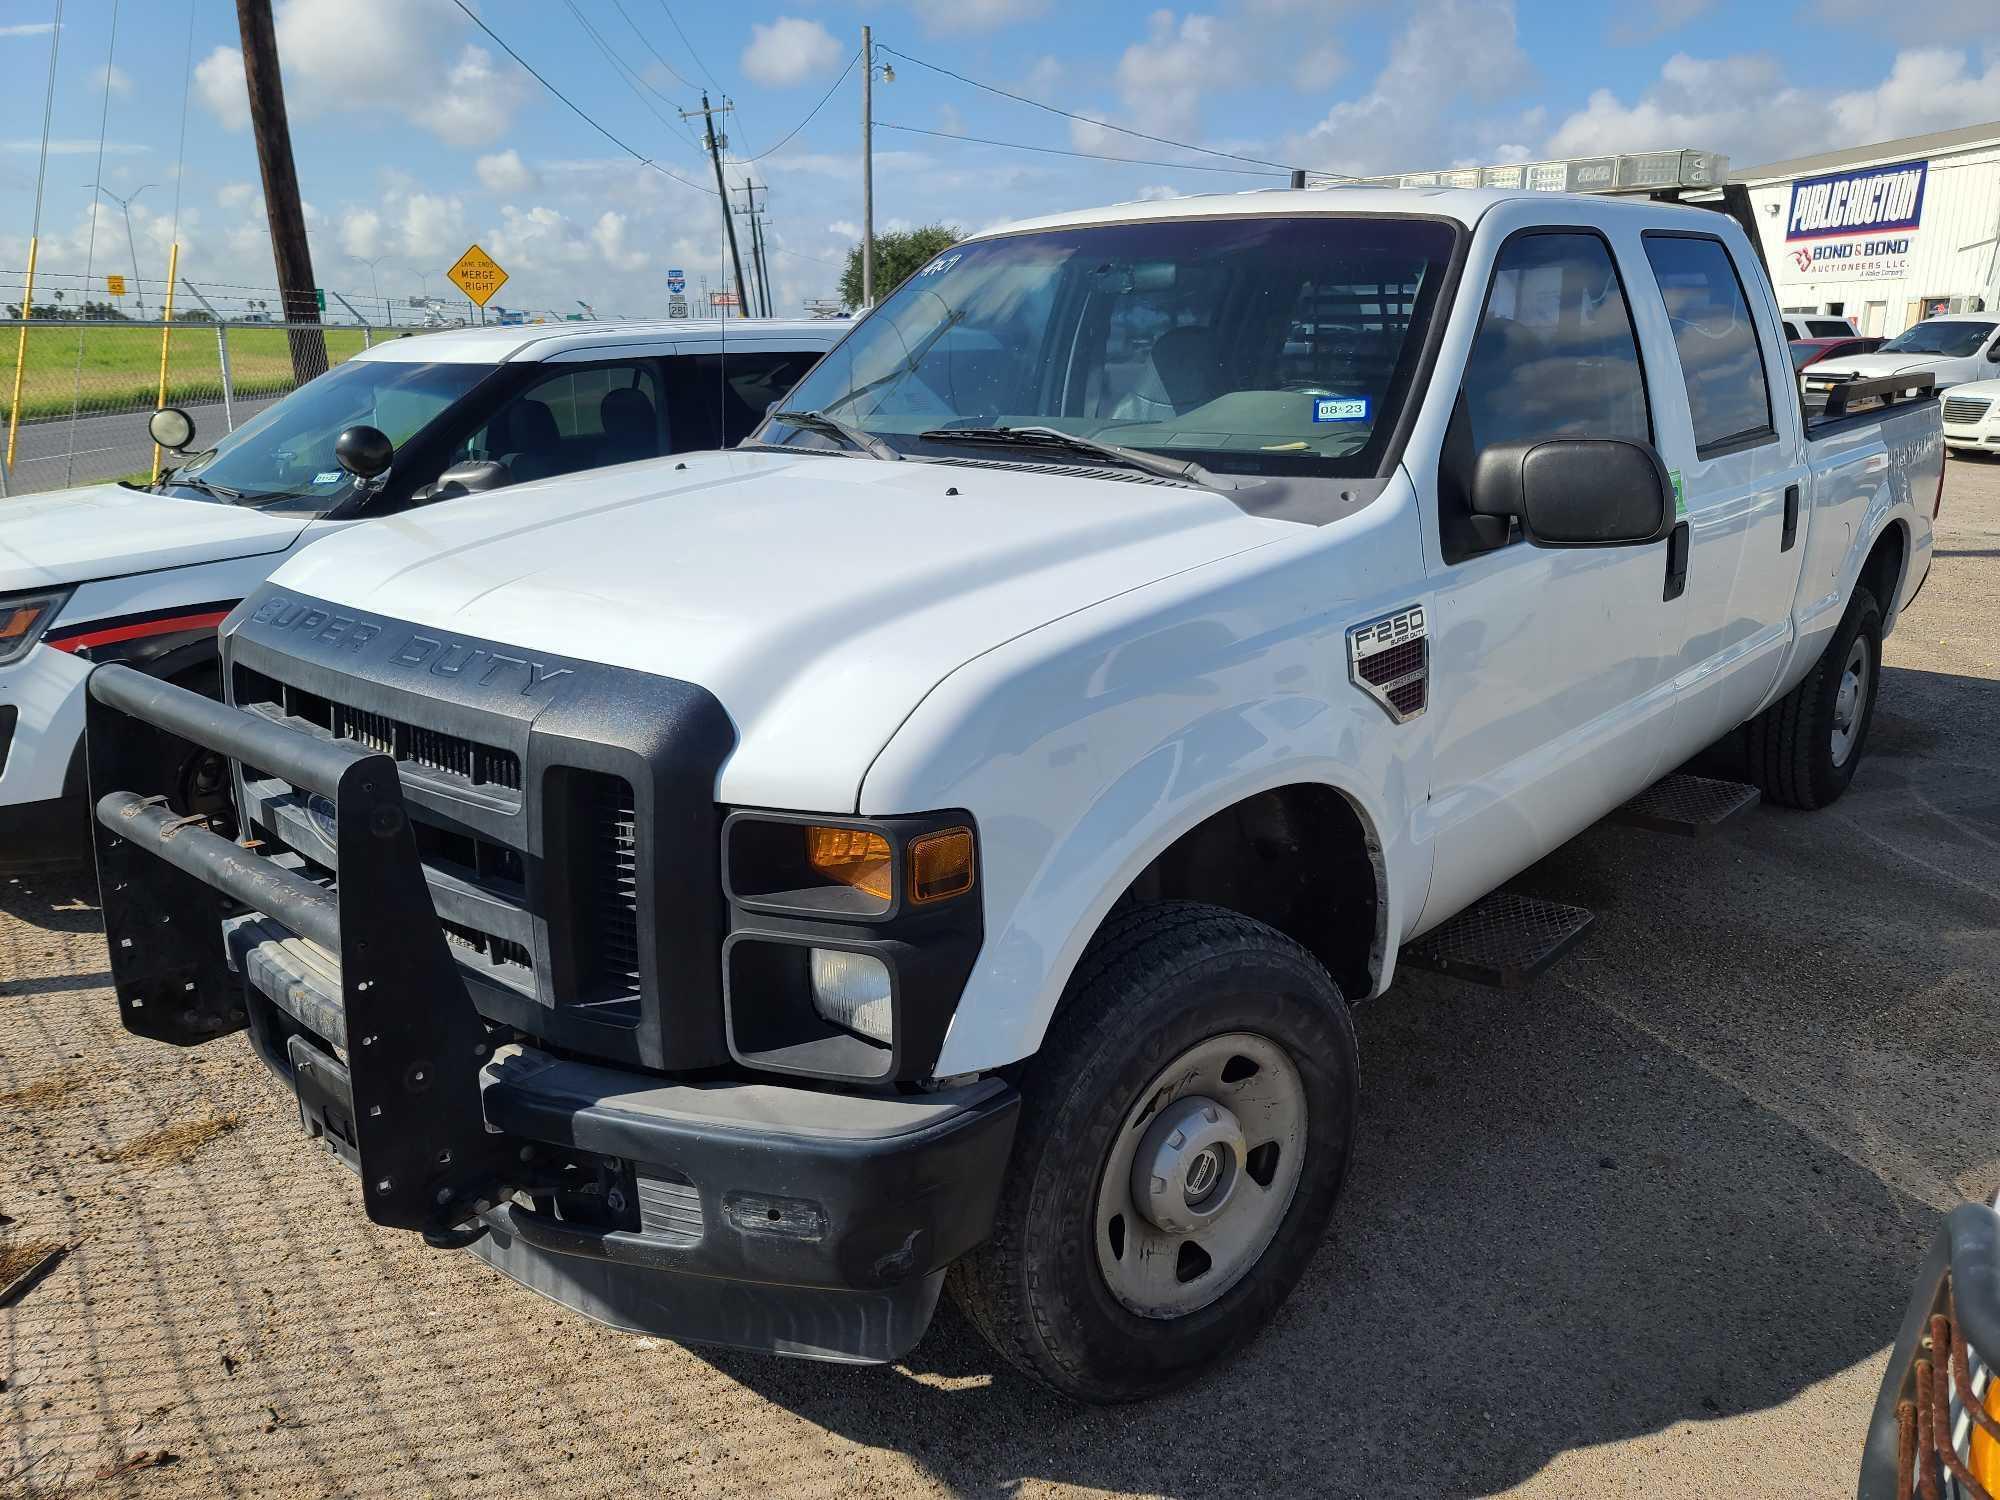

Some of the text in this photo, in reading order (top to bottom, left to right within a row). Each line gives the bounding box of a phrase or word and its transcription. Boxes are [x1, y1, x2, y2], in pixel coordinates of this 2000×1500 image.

[1790, 169, 1923, 232] PUBLIC AUCTION
[1813, 238, 1909, 260] BOND & BOND
[1811, 261, 1881, 273] AUCTIONEERS
[461, 270, 496, 280] MERGE
[465, 281, 496, 291] RIGHT
[671, 306, 686, 315] 281
[1320, 404, 1362, 415] 08 23
[1390, 627, 1425, 646] SUPER DUTY
[251, 596, 576, 697] SUPER DUTY
